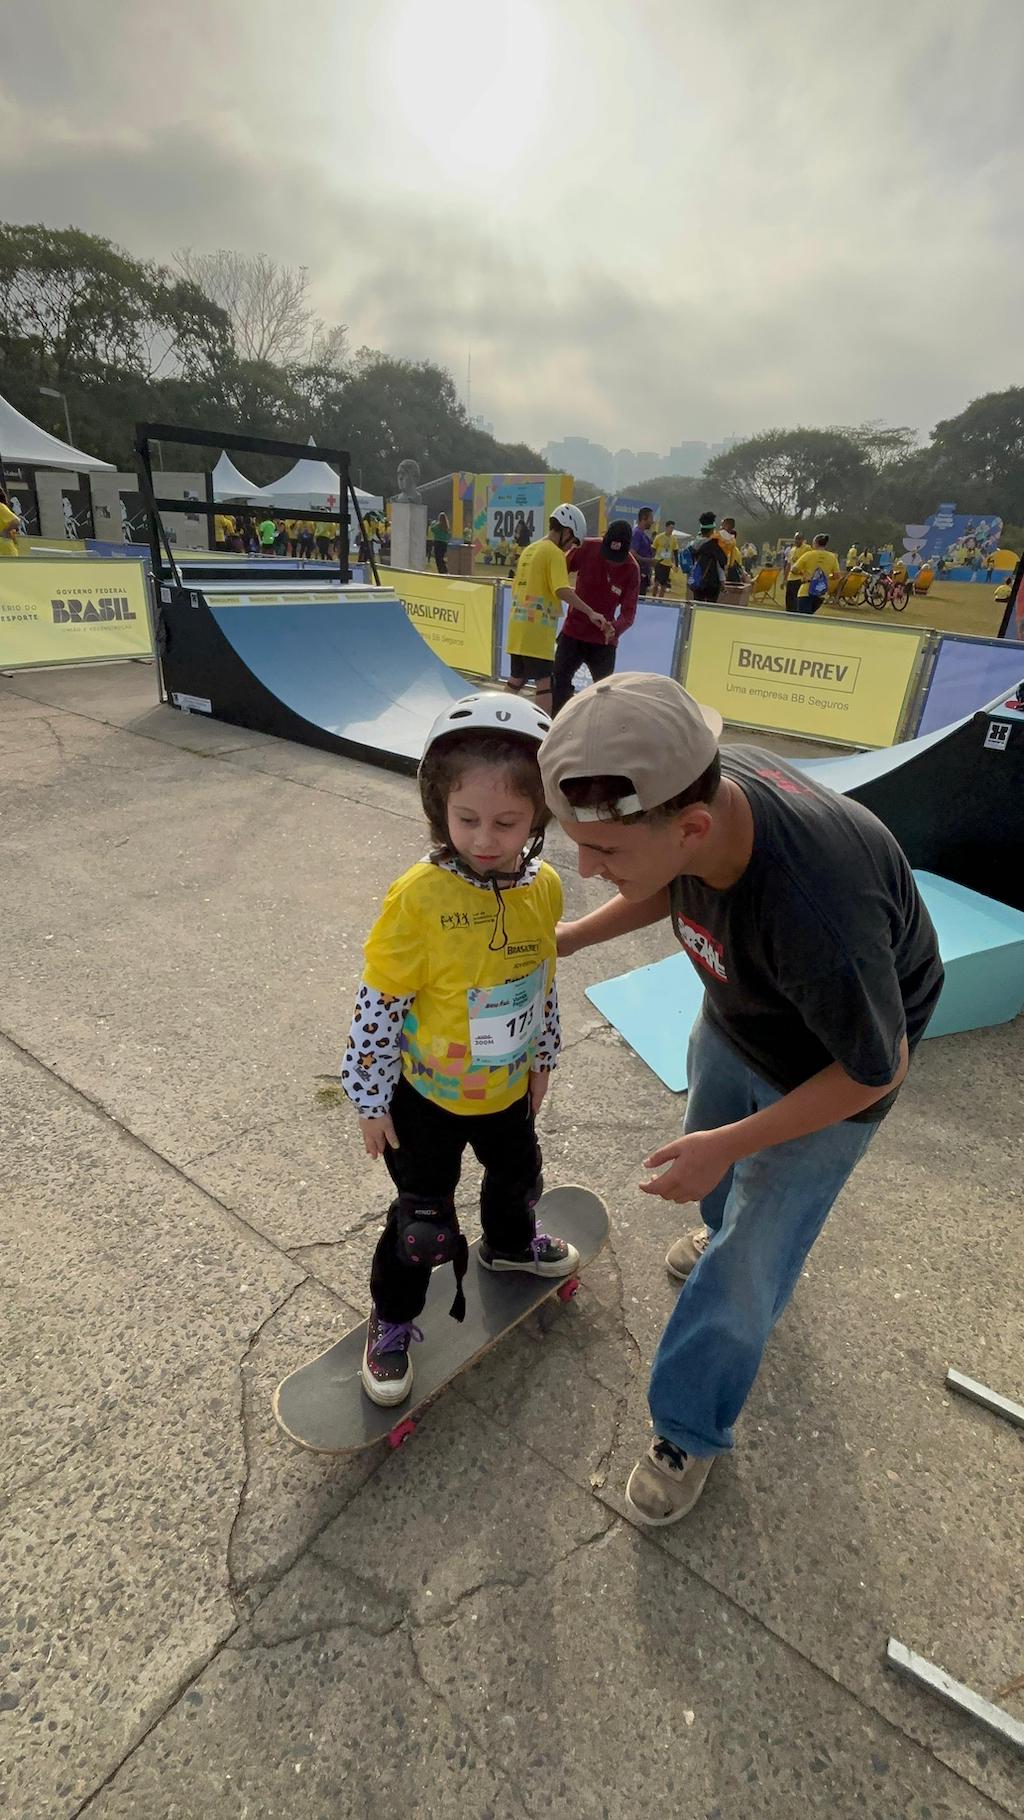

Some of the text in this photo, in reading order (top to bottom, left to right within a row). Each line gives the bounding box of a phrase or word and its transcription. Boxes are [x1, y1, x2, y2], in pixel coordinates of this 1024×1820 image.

[51, 597, 137, 624] BRASIL
[738, 648, 849, 682] BRASILPREV
[726, 682, 850, 712] Uma empresa BB Seguros
